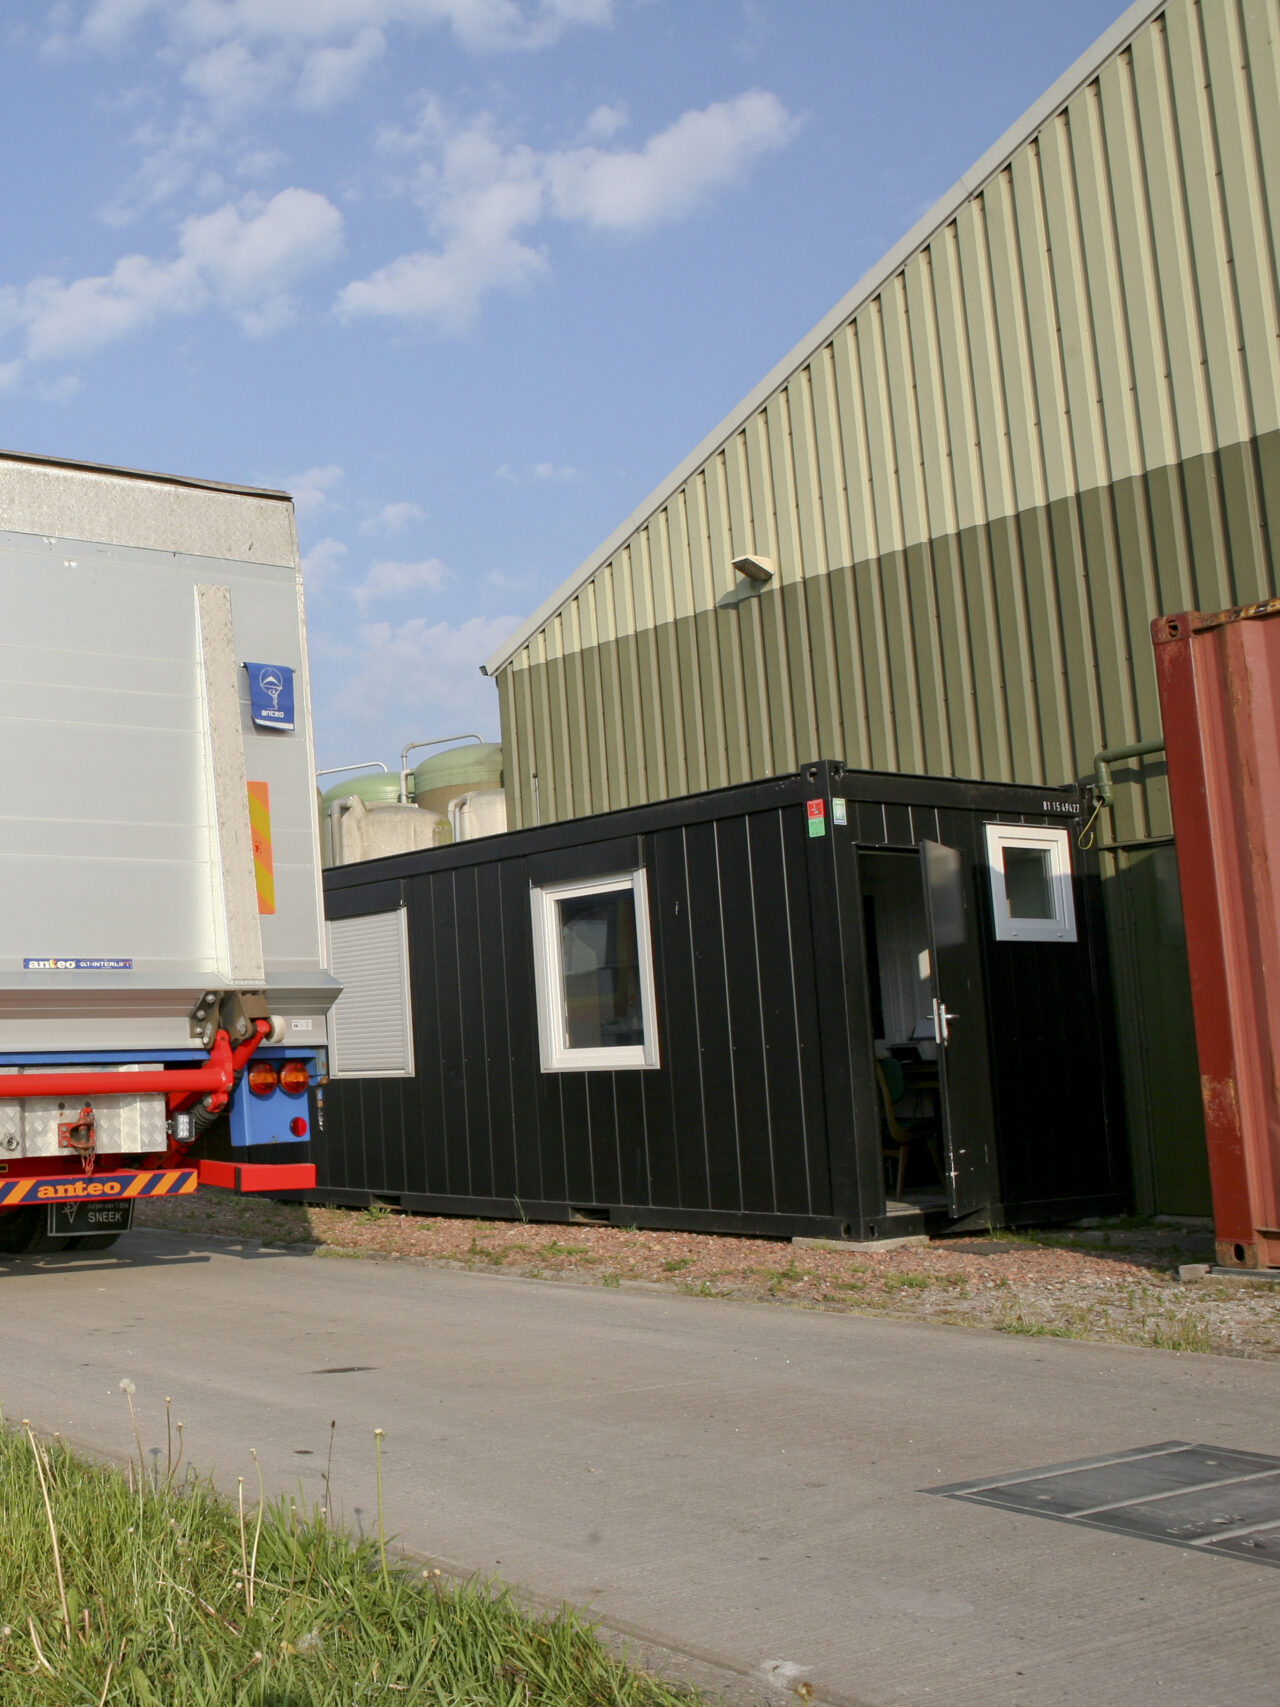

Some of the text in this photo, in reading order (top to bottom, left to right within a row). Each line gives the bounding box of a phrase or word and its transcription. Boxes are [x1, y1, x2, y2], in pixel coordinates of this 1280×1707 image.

[261, 709, 285, 718] anteo
[28, 959, 77, 969] anteo
[37, 1181, 121, 1198] anteo
[88, 1211, 122, 1223] SNEEK
